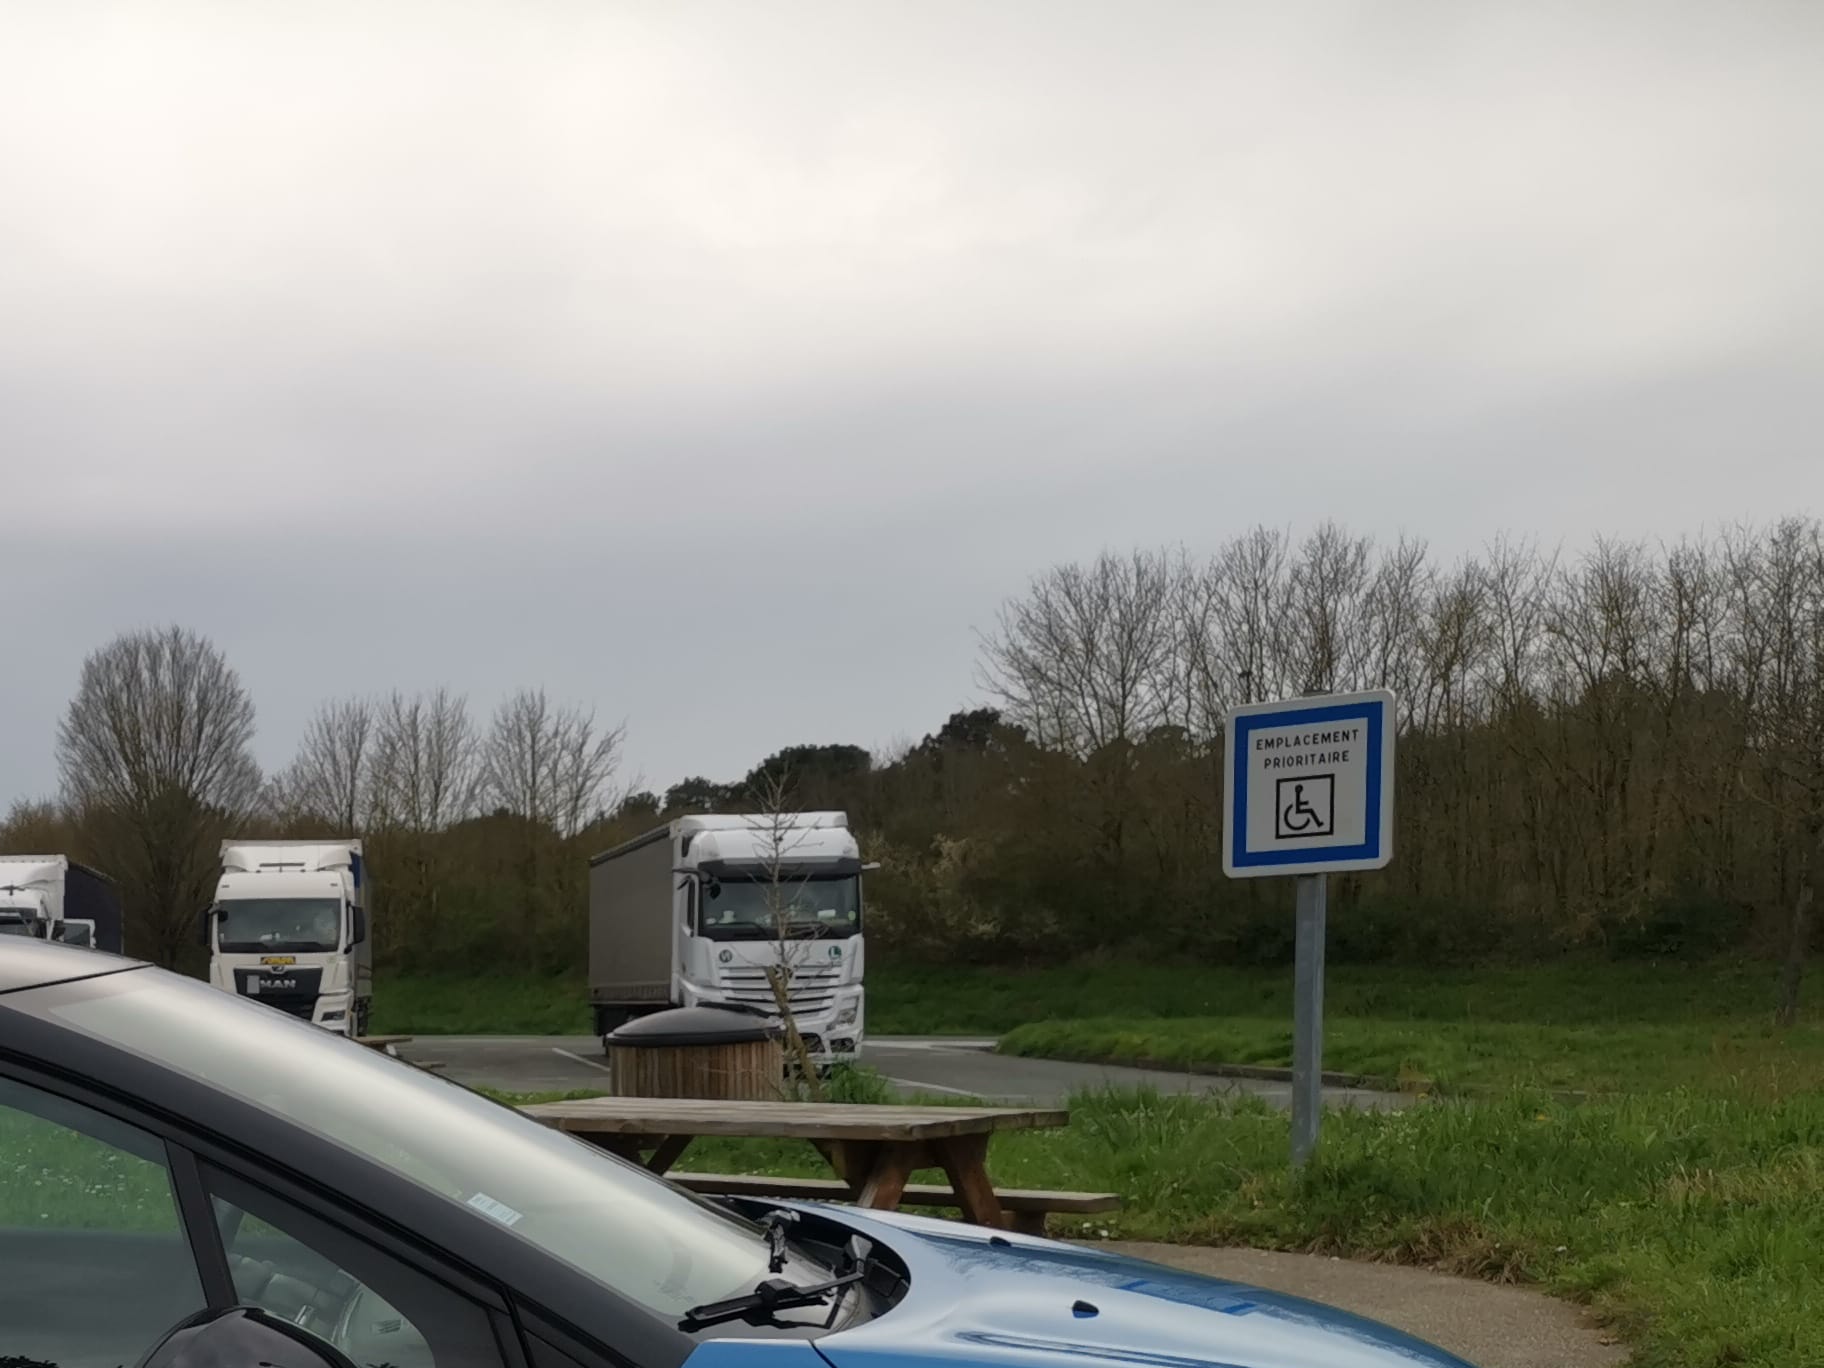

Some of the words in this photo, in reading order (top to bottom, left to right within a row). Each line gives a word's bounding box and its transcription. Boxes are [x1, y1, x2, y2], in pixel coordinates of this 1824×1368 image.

[1256, 729, 1359, 750] EMPLACEMENT
[1264, 750, 1350, 769] PRIORITAIRE
[260, 980, 296, 989] MAN
